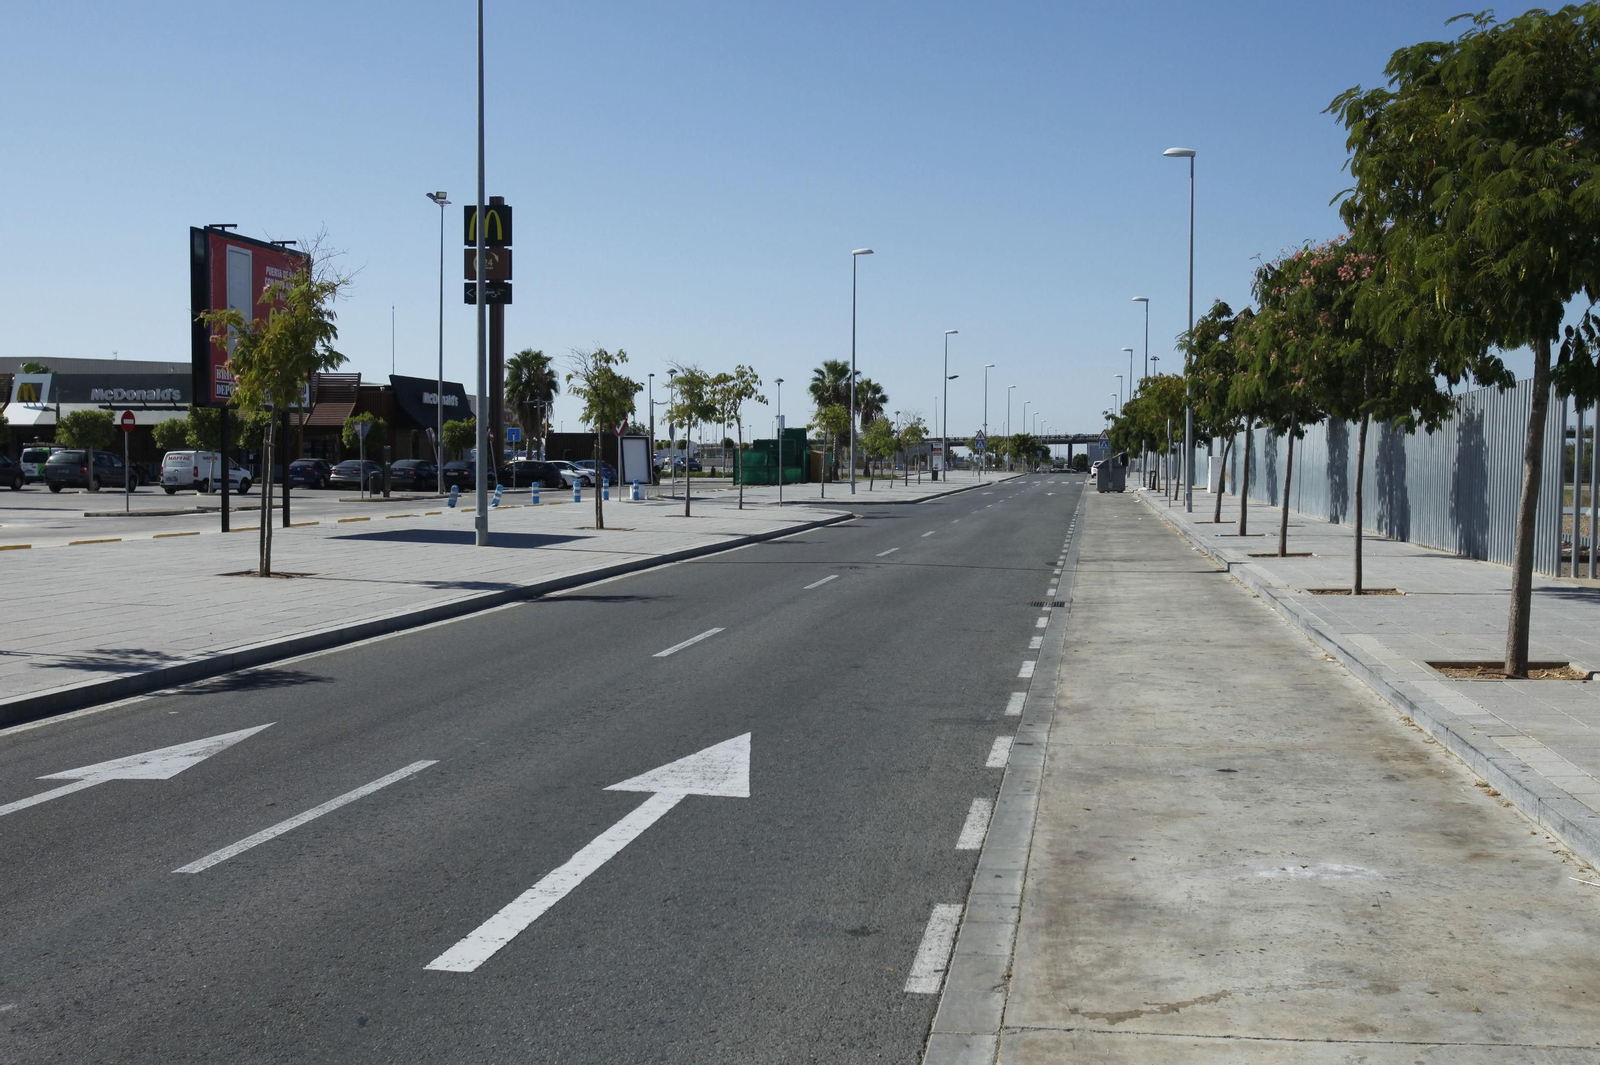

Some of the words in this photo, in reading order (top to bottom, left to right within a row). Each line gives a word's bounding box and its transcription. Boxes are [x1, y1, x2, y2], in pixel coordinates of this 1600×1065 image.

[266, 266, 283, 278] PUERTA
[90, 388, 182, 401] McDonald's
[422, 392, 459, 406] McDnald's
